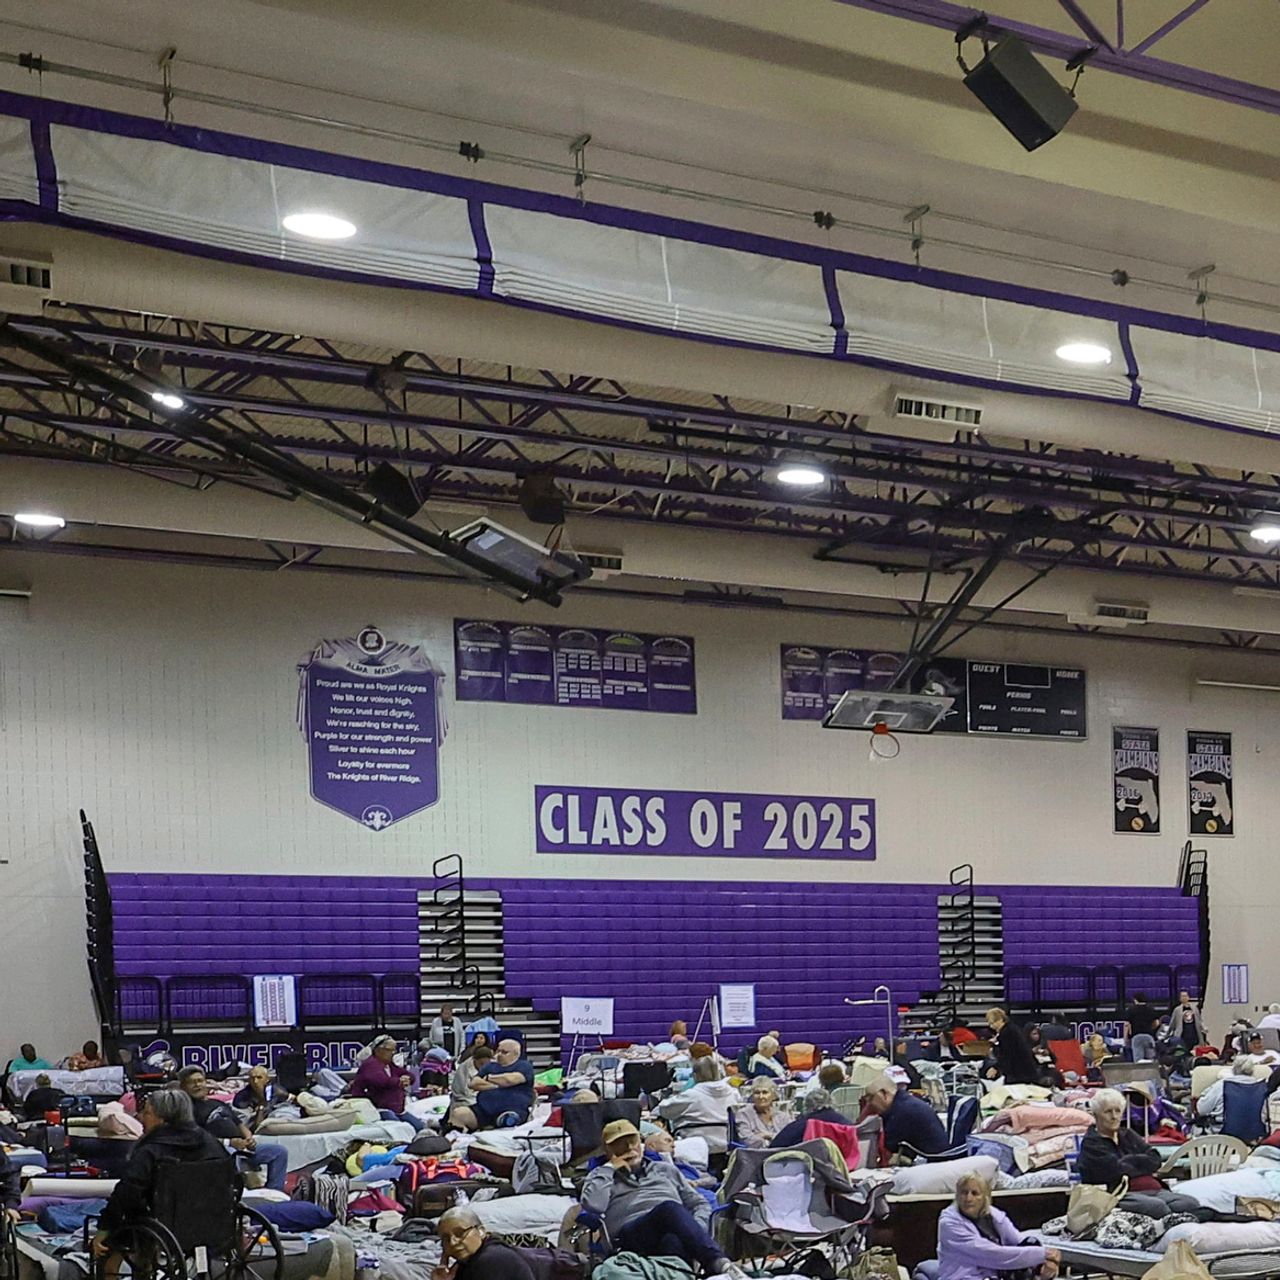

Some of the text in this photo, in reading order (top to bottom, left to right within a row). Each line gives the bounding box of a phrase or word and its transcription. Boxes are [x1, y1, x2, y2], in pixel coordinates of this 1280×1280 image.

[346, 662, 400, 674] ALMA MATER
[972, 664, 1000, 673] GUEST
[316, 680, 339, 688] Proud
[376, 683, 397, 692] Royal
[399, 684, 427, 694] Knights
[349, 720, 379, 730] reaching
[381, 721, 391, 729] for
[314, 732, 338, 741] Purple
[339, 732, 349, 740] for
[365, 733, 394, 743] strength
[396, 735, 409, 743] and
[329, 745, 416, 755] Silver to shine each hour
[338, 760, 410, 770] Loyalty for evermore
[328, 772, 341, 780] The
[342, 773, 369, 782] Knights
[371, 773, 378, 781] of
[380, 774, 398, 782] River
[540, 793, 872, 851] CLASS OF 2025
[584, 1004, 591, 1013] 9
[572, 1017, 602, 1026] Middle
